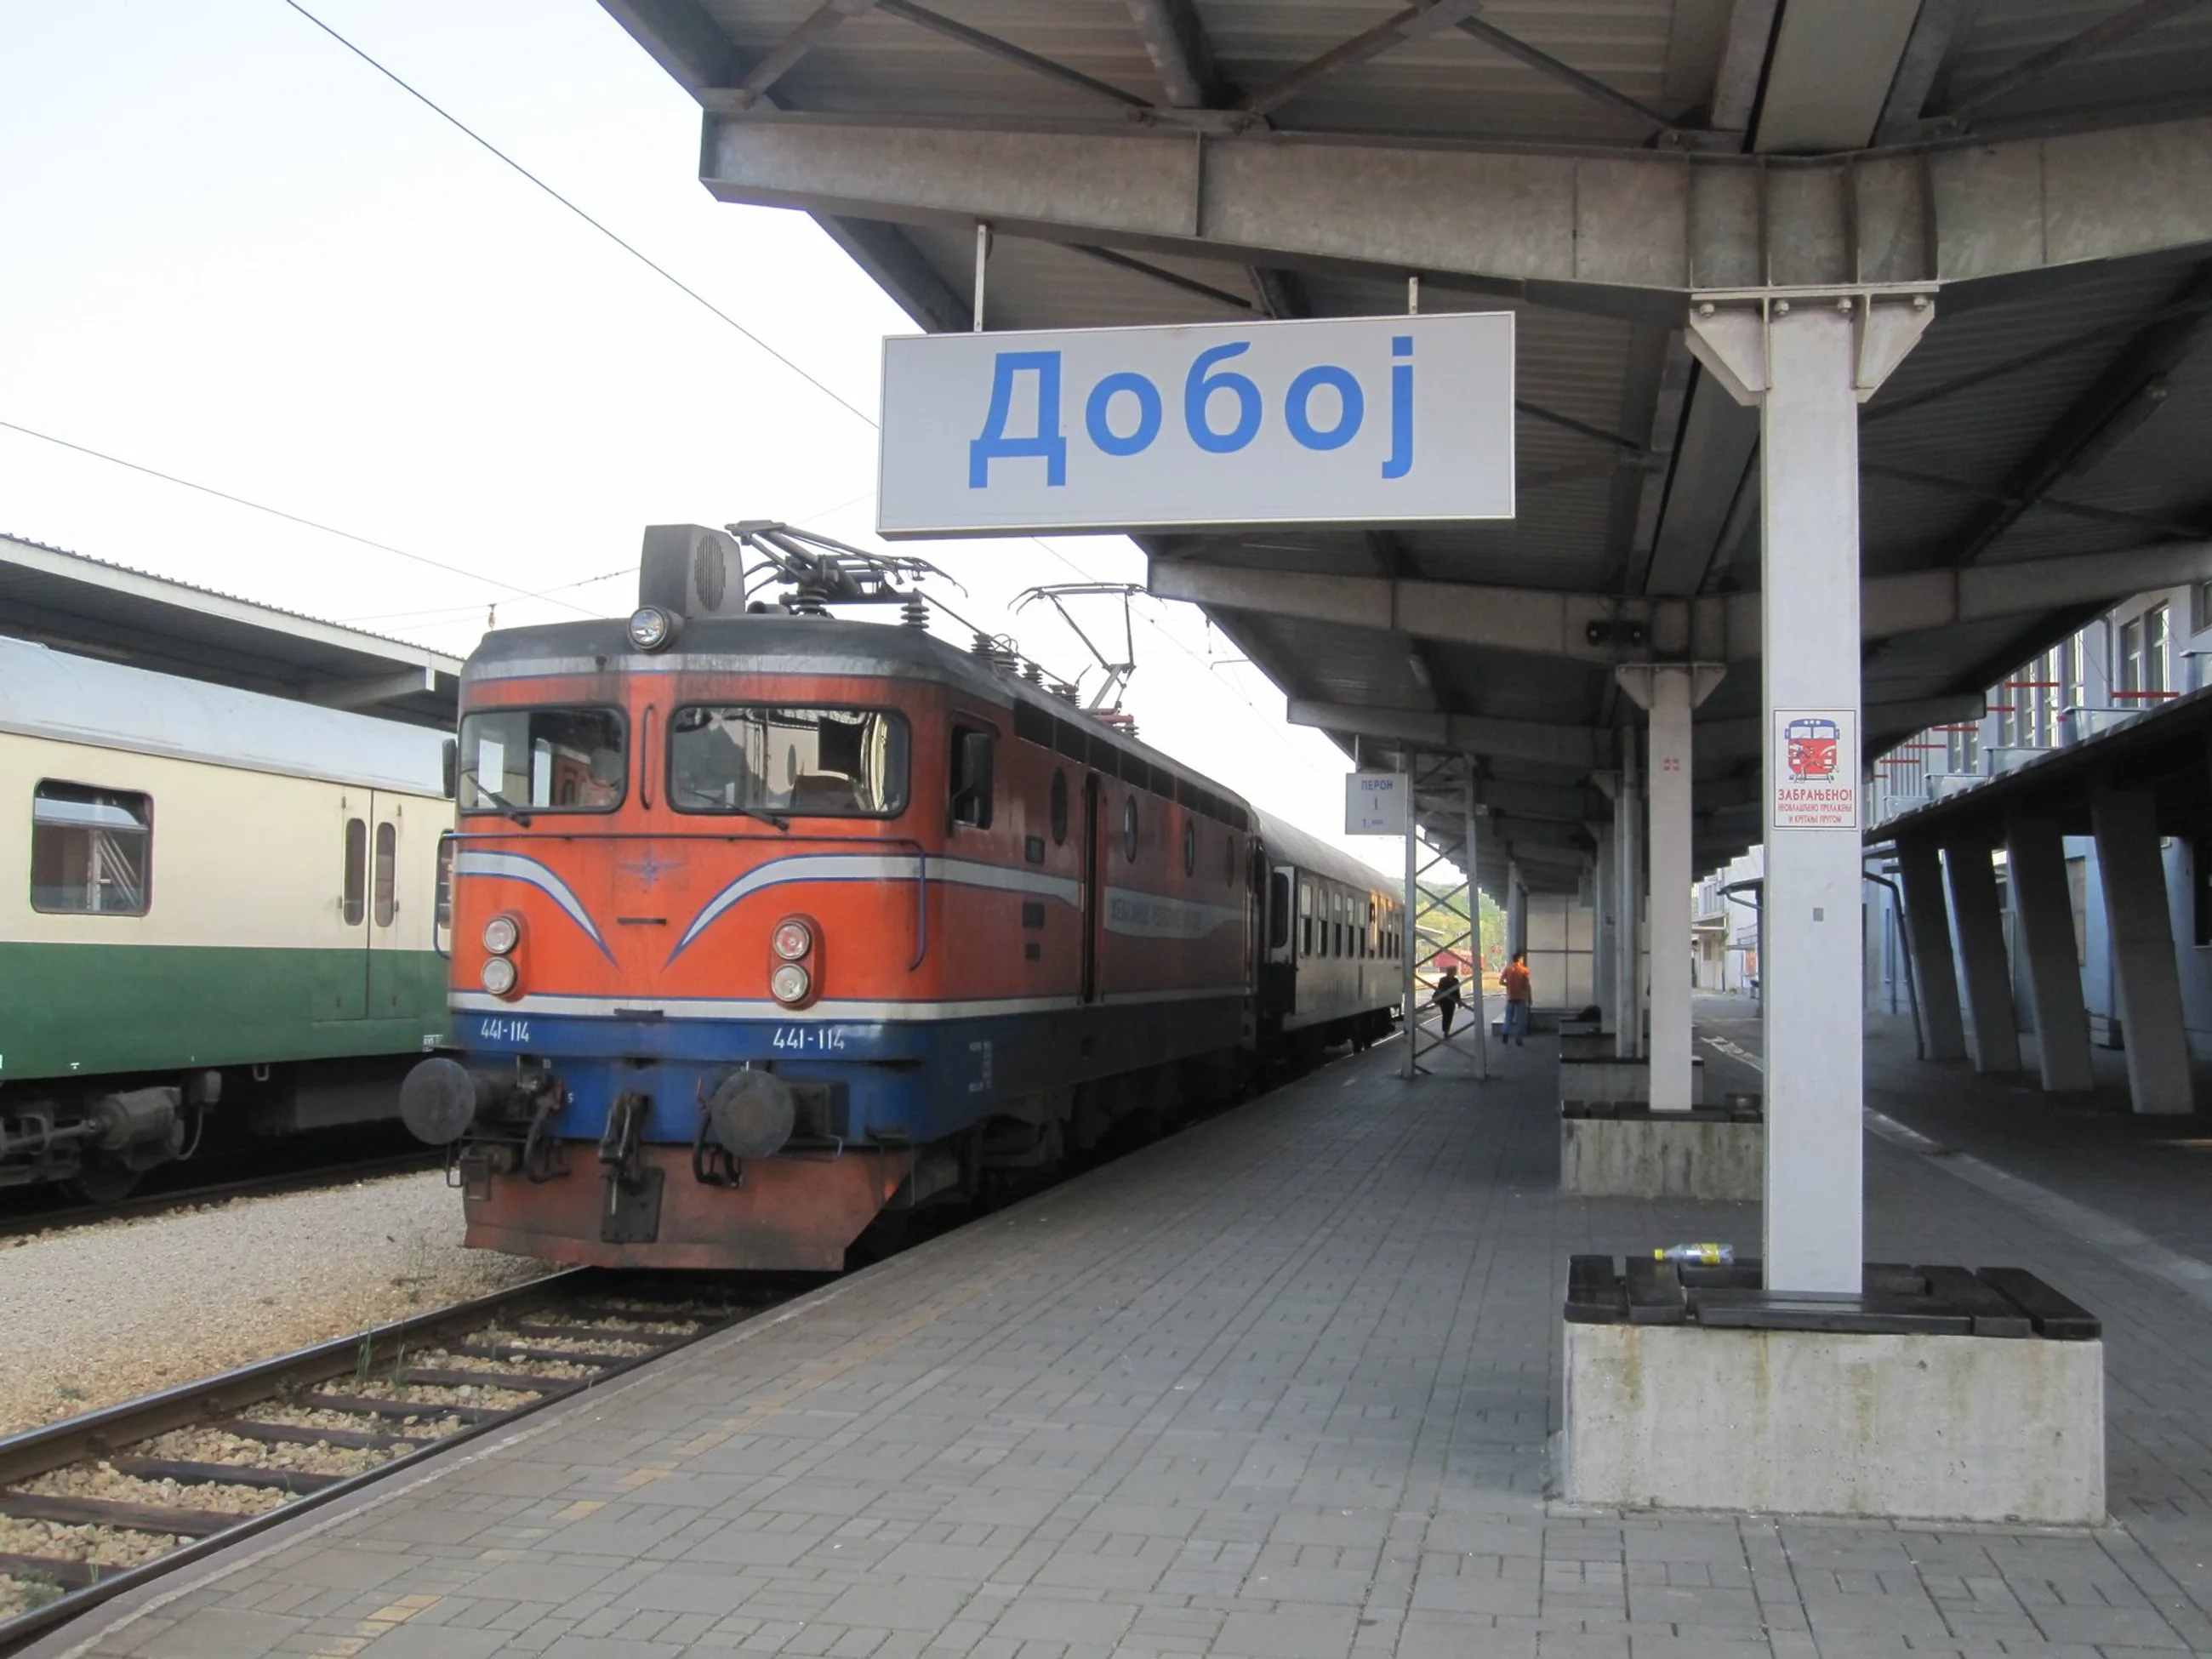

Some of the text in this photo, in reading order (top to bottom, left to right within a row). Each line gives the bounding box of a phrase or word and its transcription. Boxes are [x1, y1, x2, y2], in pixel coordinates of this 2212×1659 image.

[968, 335, 1414, 490] Добој
[1361, 779, 1393, 790] ПЕРОН
[1778, 789, 1852, 801] ЗАБРАЊЕНО!
[481, 1019, 529, 1042] 441-114
[773, 1028, 845, 1050] 441-114
